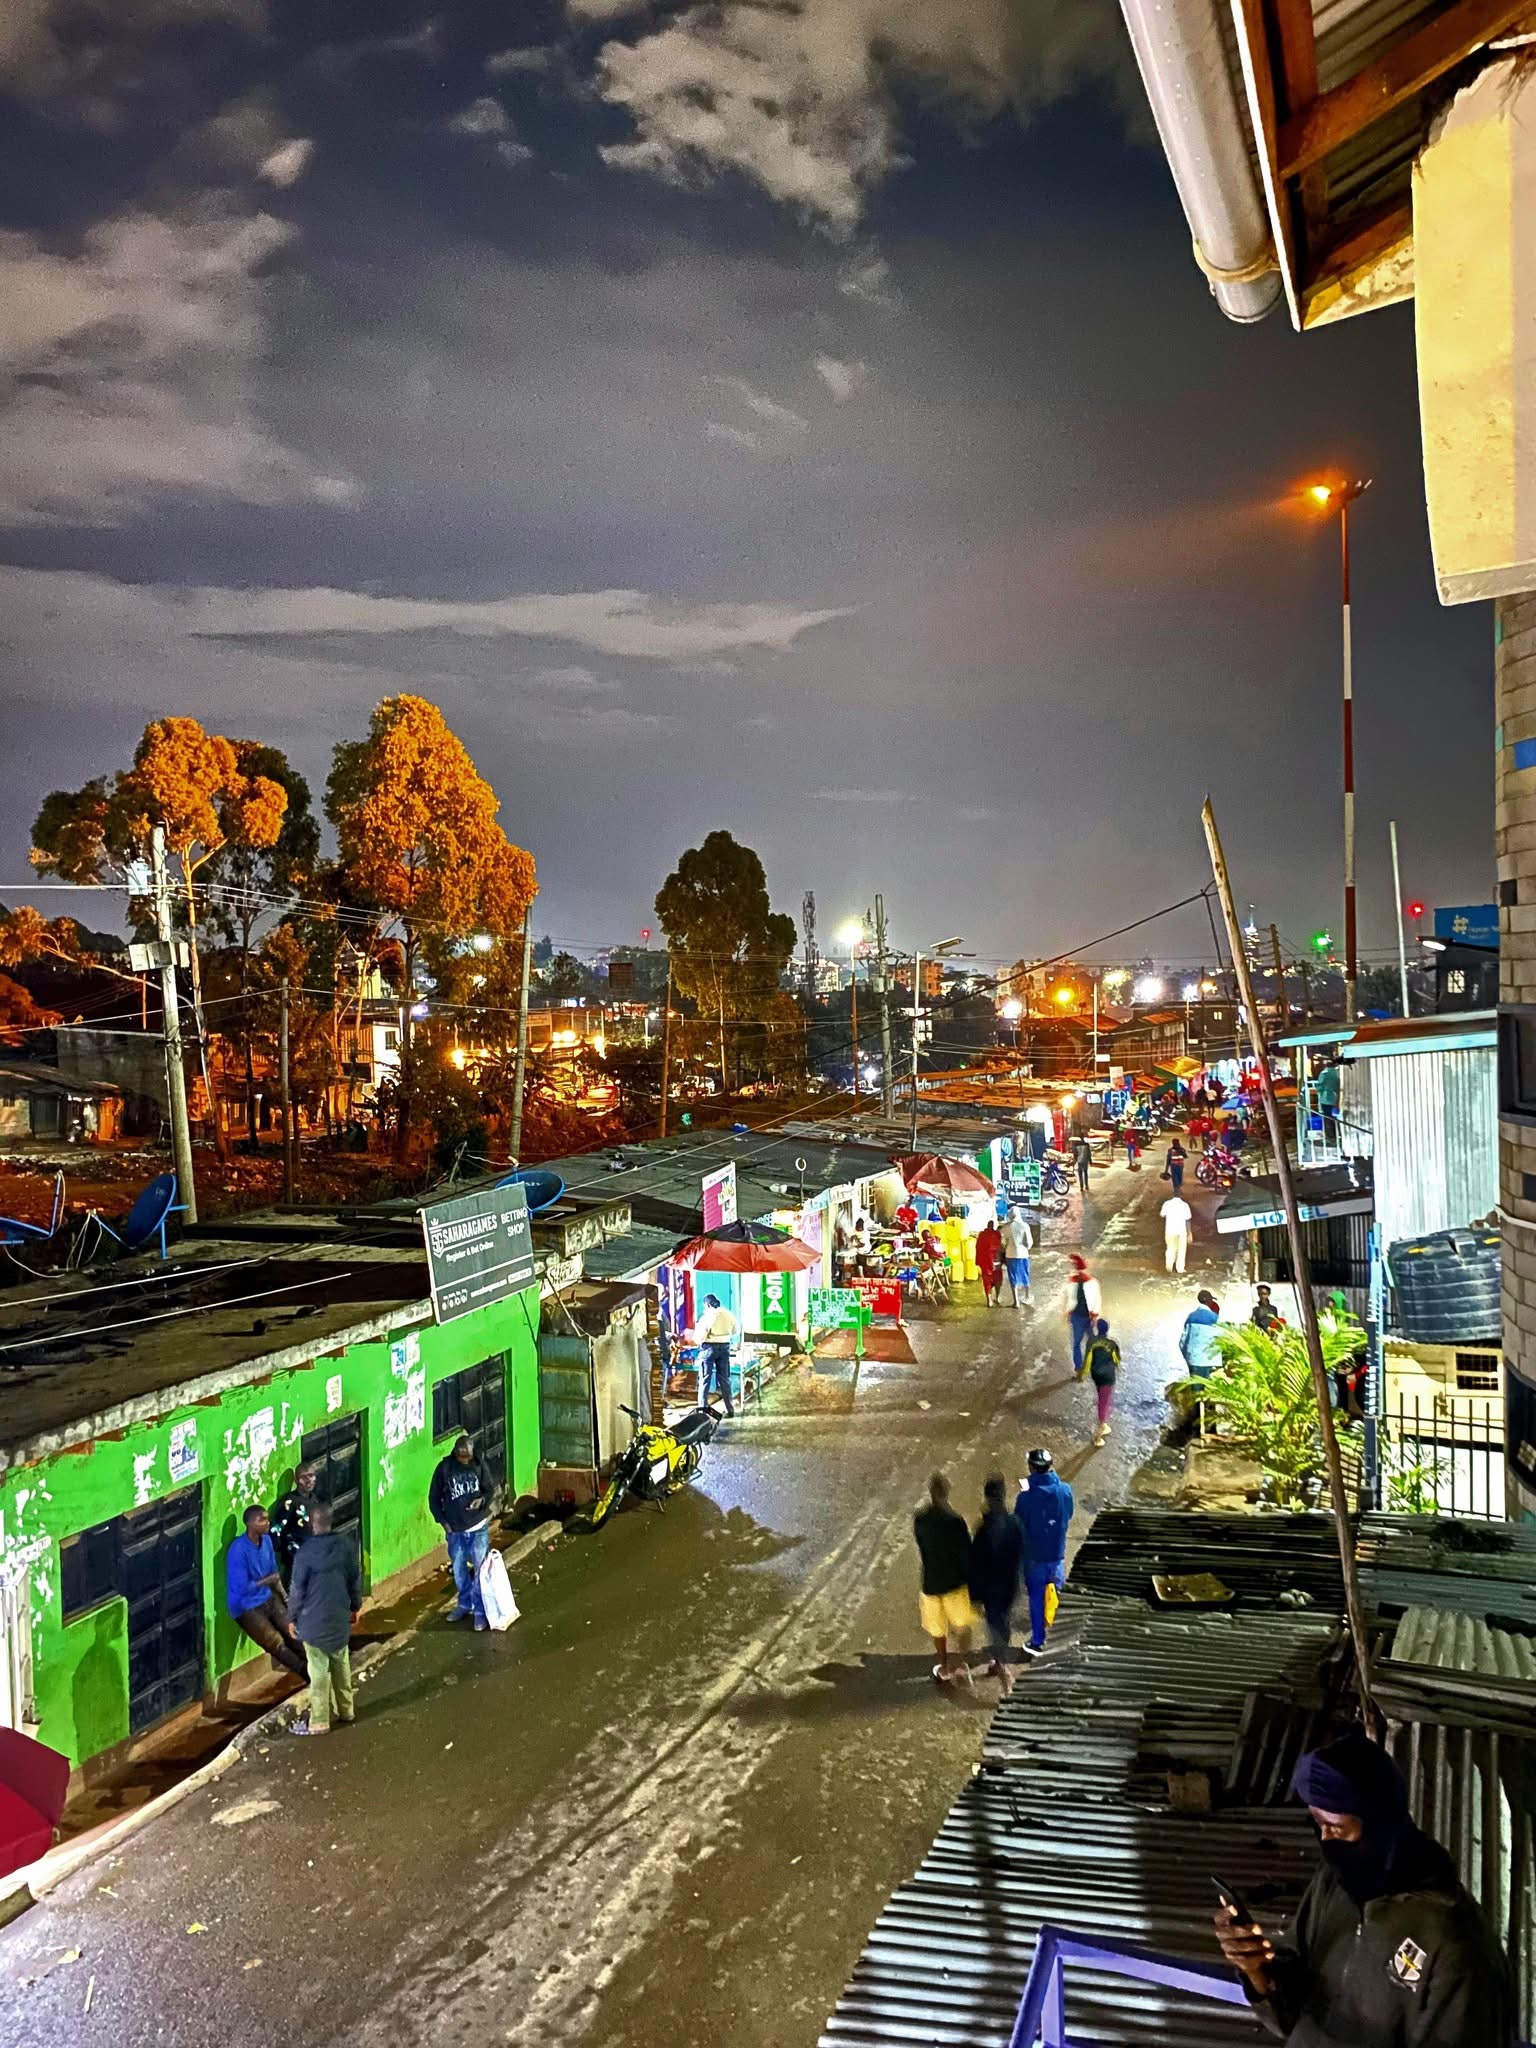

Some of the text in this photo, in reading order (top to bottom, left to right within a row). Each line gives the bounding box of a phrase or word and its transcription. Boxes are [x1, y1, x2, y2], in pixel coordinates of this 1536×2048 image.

[501, 1207, 528, 1224] BETTING
[1253, 1205, 1328, 1226] HOEL
[443, 1215, 498, 1245] SAHARAGAMES
[507, 1223, 525, 1237] SHOP
